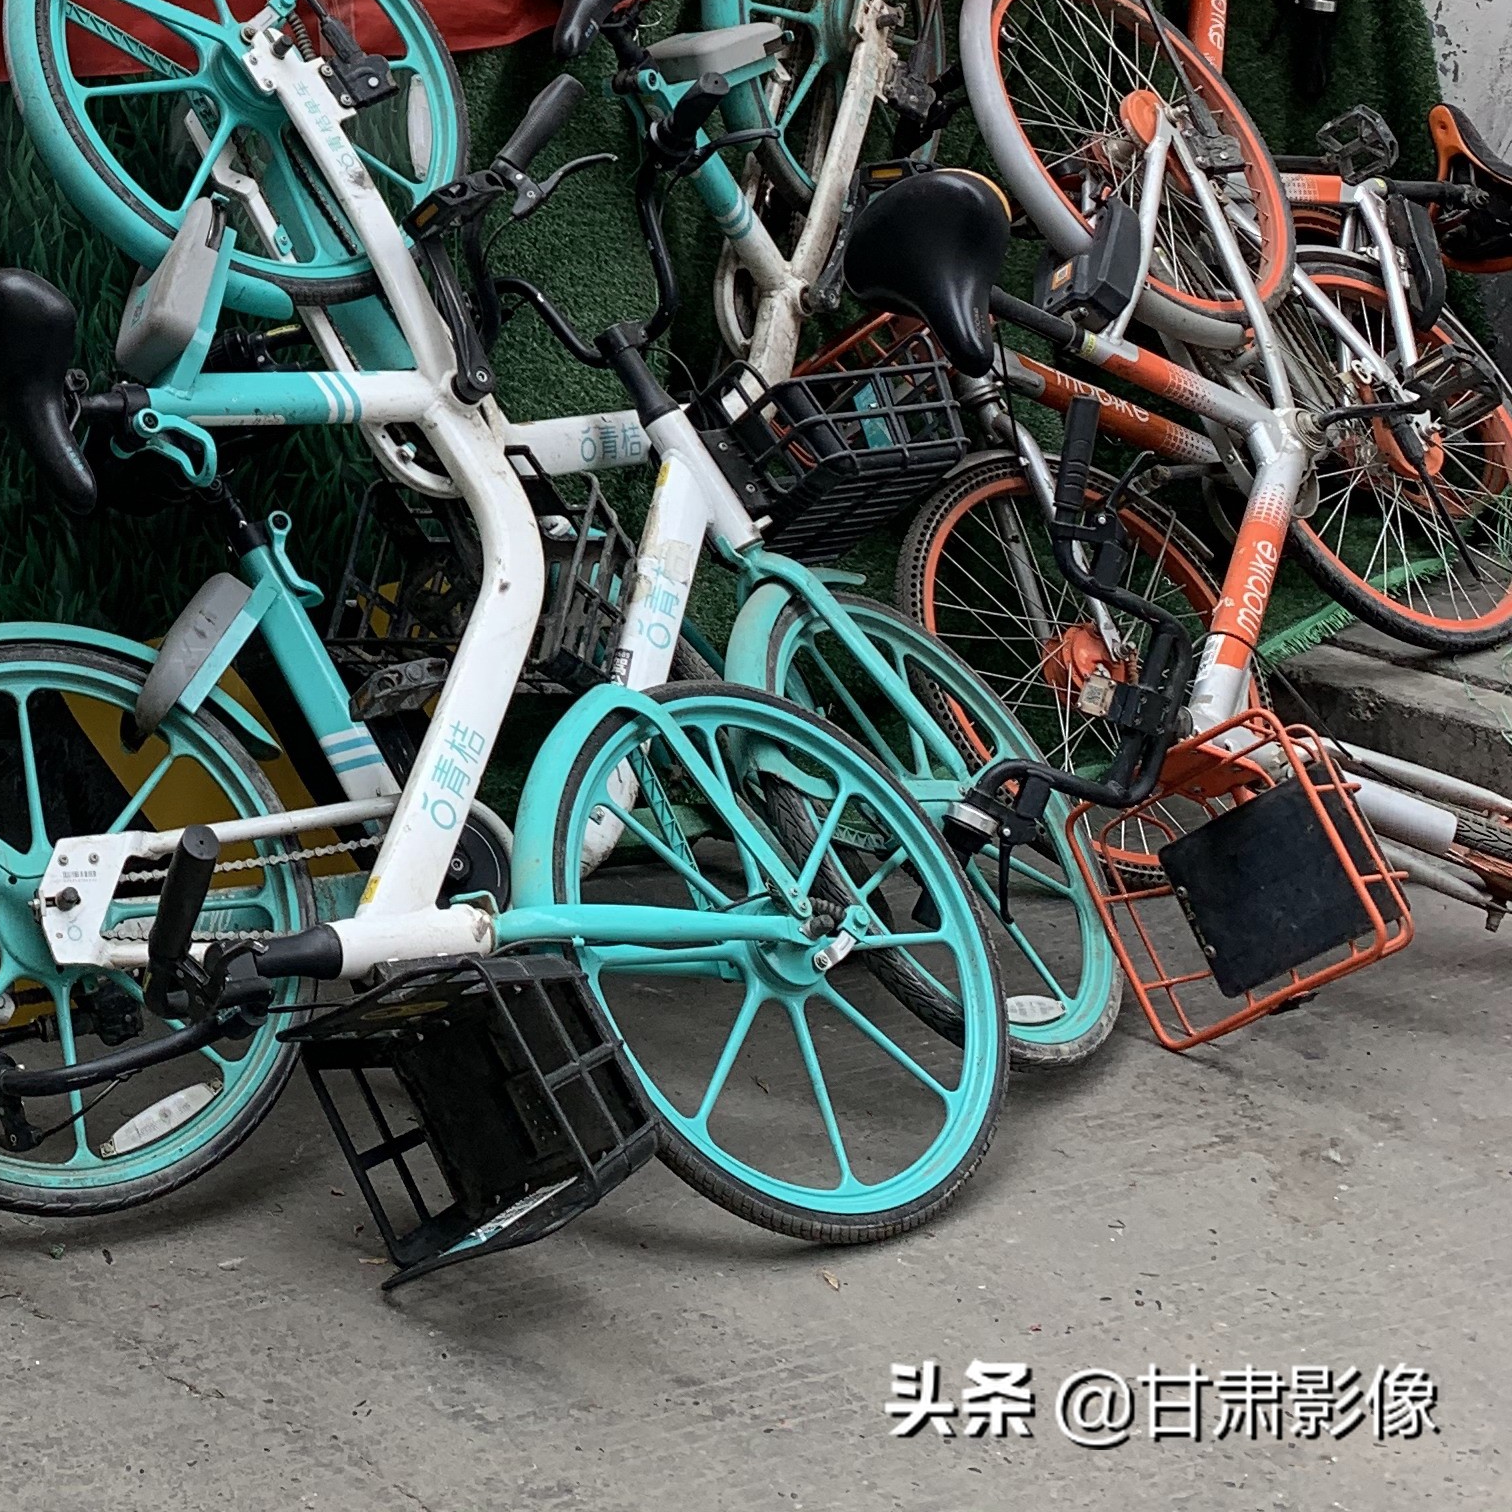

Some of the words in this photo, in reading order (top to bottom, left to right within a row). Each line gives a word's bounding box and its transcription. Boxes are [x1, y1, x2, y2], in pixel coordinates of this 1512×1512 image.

[293, 80, 346, 153] 青桔单车
[1055, 369, 1150, 423] mobike
[598, 422, 642, 461] 青桔
[1236, 540, 1278, 639] mobike
[431, 719, 486, 801] 青桔
